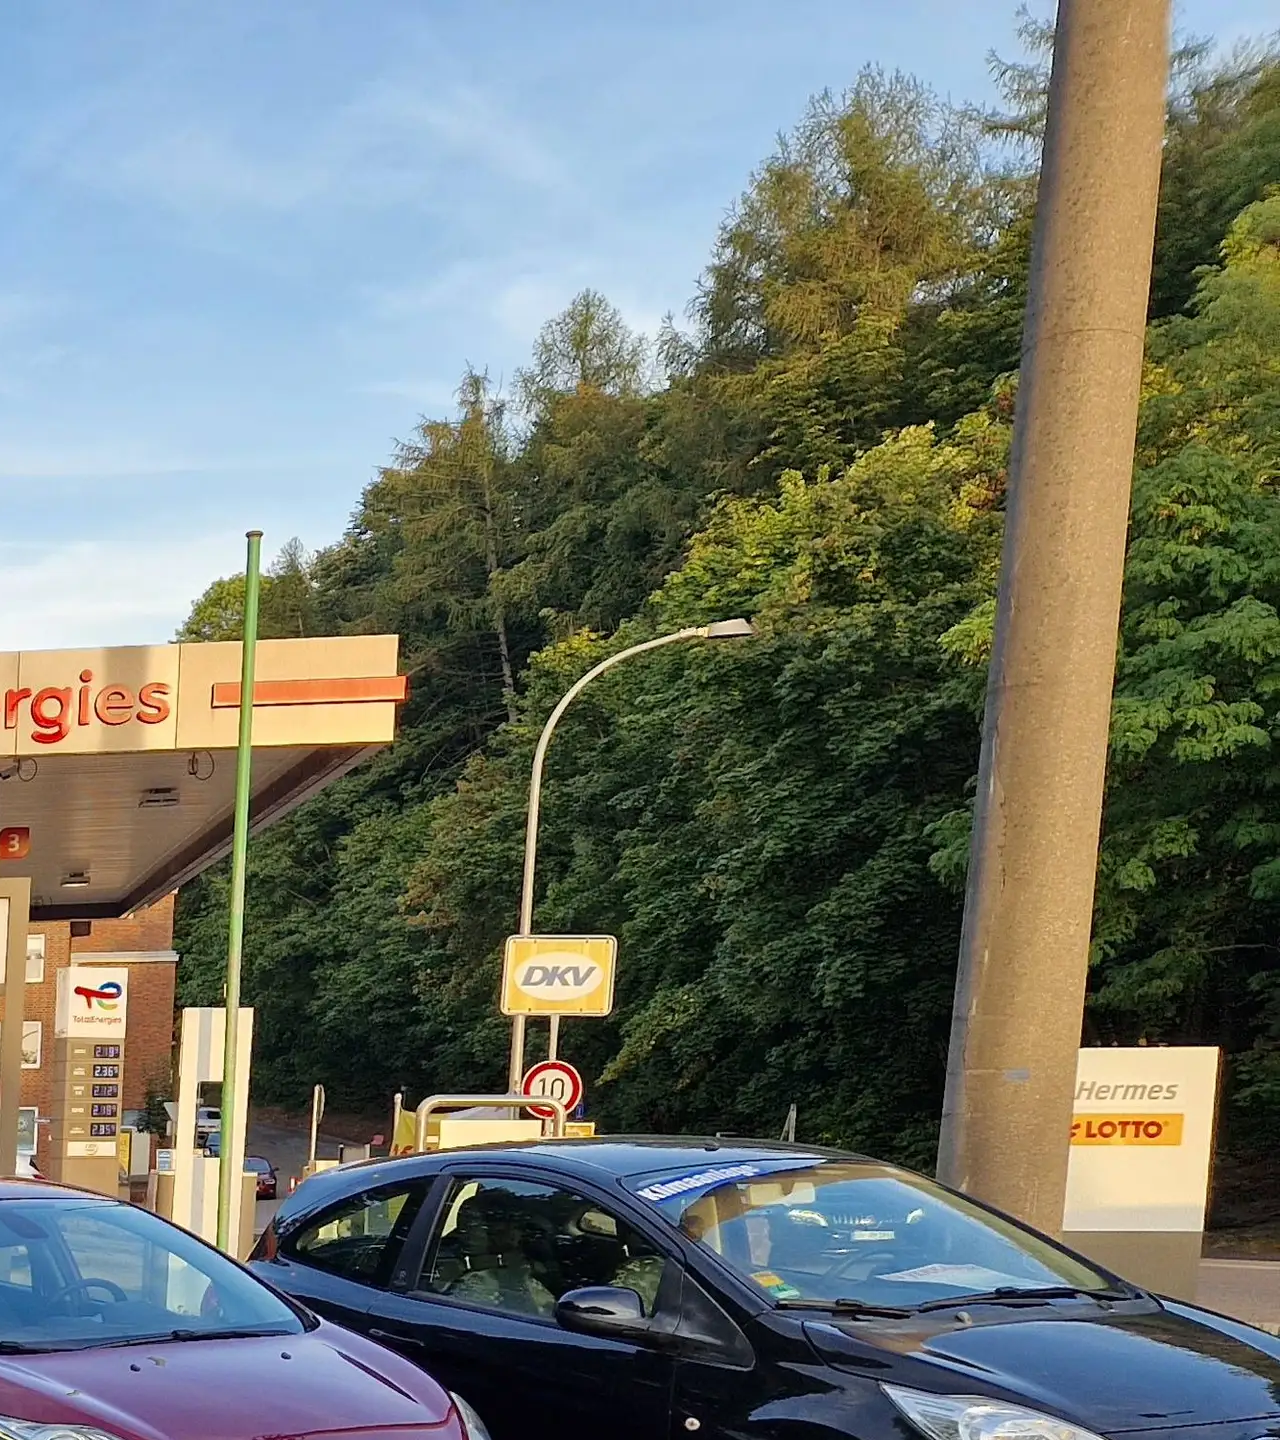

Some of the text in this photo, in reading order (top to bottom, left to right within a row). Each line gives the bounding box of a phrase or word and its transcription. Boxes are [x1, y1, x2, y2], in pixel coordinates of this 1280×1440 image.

[7, 833, 20, 852] 3
[521, 966, 597, 986] DKV
[538, 1077, 565, 1101] 10
[1075, 1081, 1179, 1100] Hermes
[1085, 1120, 1163, 1139] LOTTO
